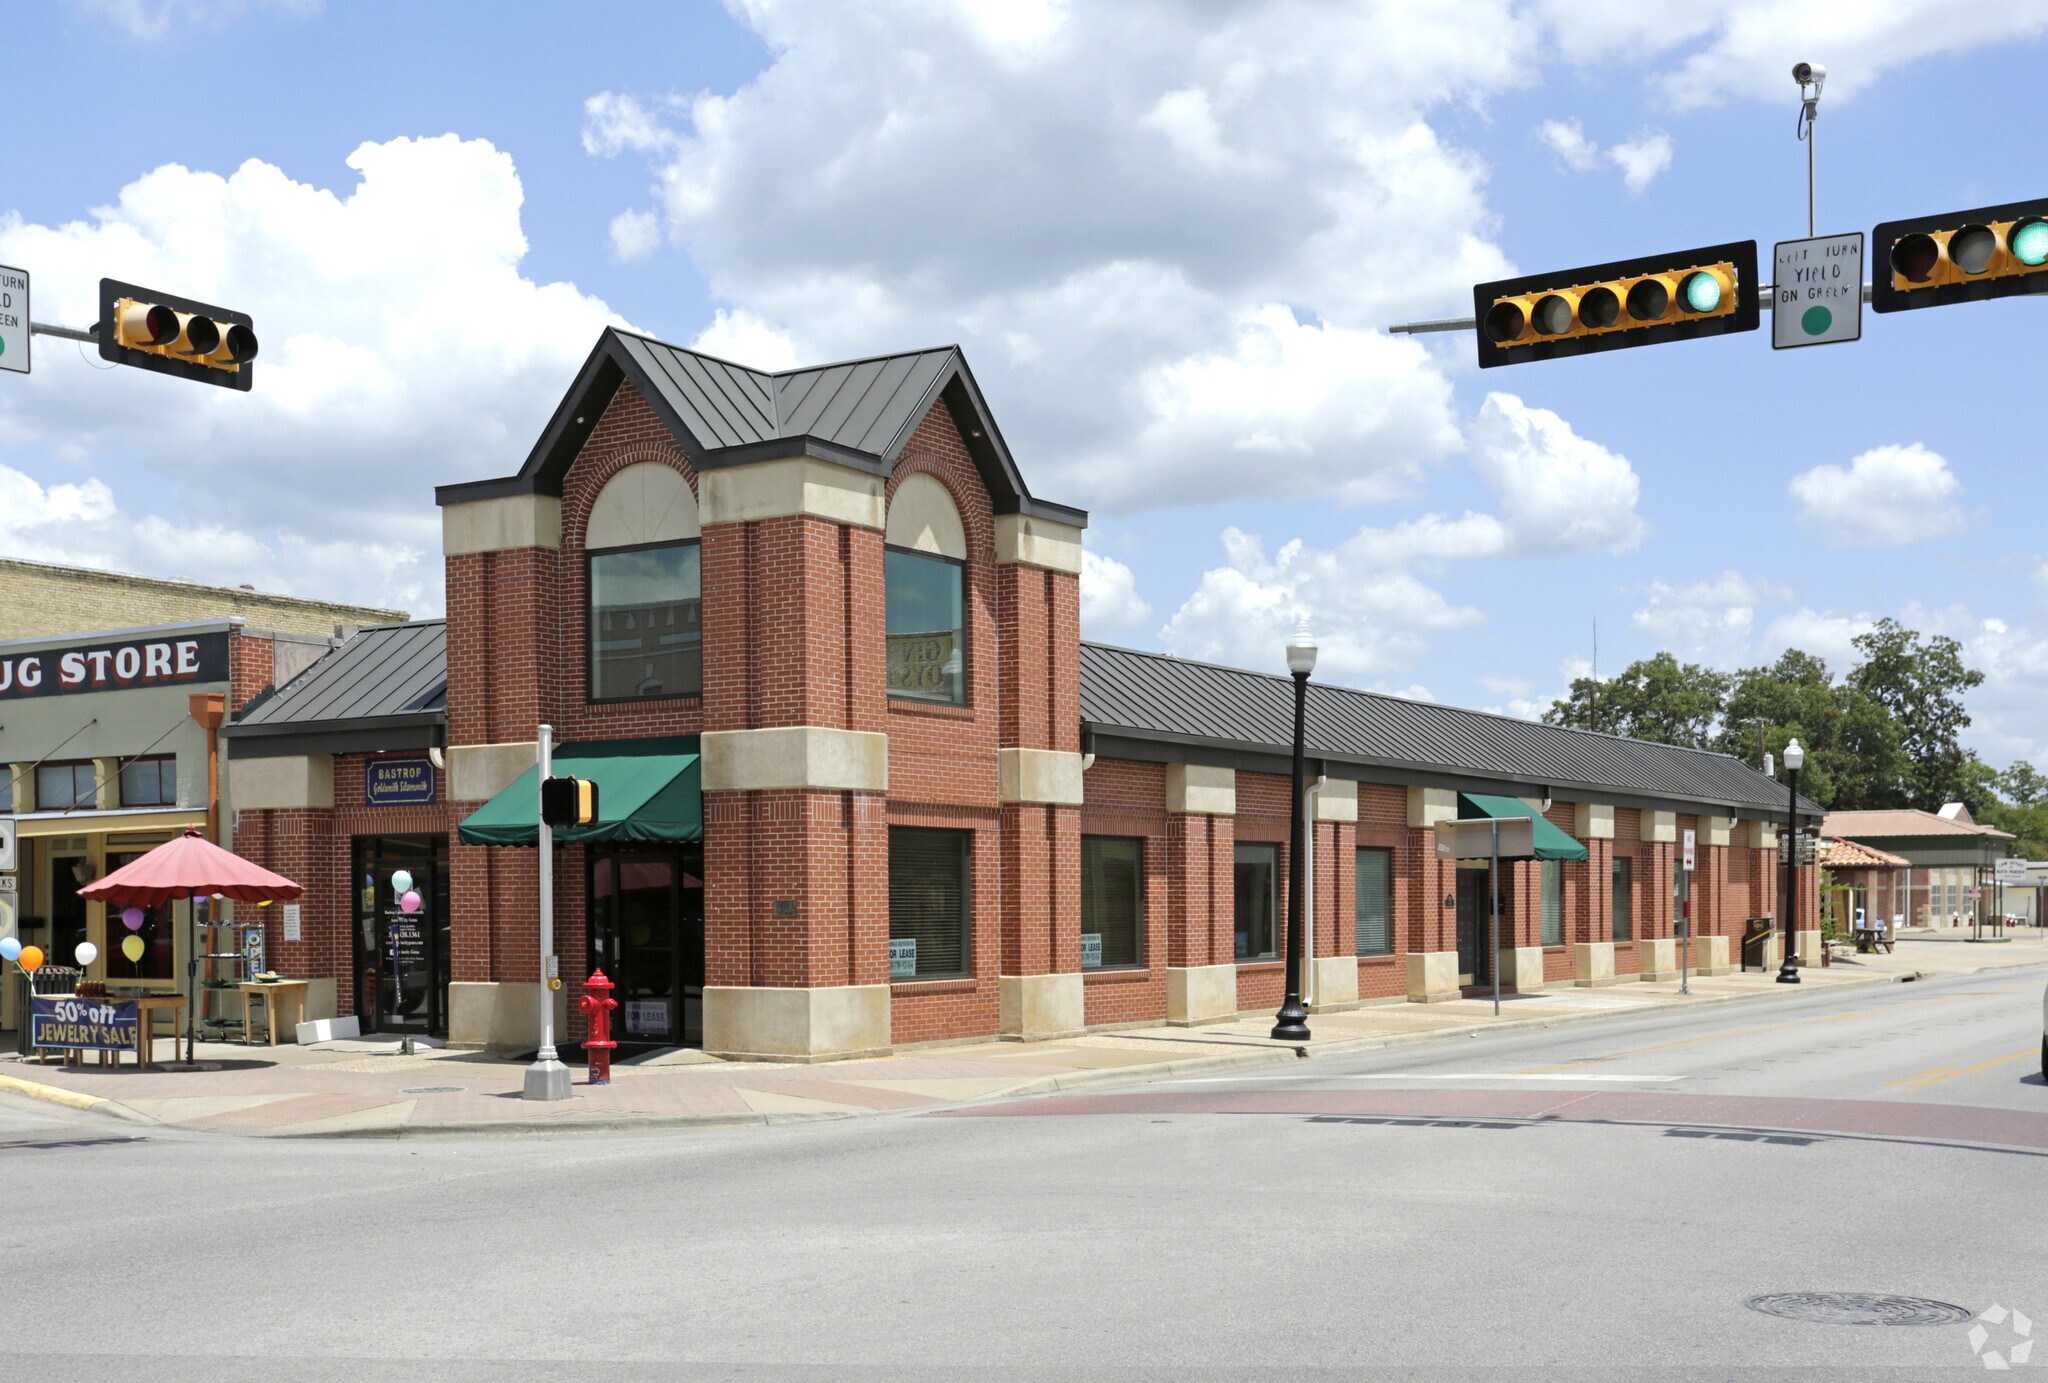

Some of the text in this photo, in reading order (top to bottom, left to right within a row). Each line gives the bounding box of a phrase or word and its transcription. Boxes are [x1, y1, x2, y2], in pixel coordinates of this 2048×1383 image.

[1826, 243, 1858, 258] TURN
[1794, 264, 1841, 283] YIELD
[0, 274, 25, 290] URN
[1781, 284, 1849, 303] ON GREEN
[0, 313, 18, 327] EEN
[0, 640, 200, 691] UG STORE
[378, 767, 422, 780] BASTROP
[889, 948, 915, 958] OR LEASE
[1089, 942, 1101, 952] LEASE
[54, 1001, 116, 1025] 50% off
[627, 1011, 665, 1022] FOR LEASE
[37, 1023, 136, 1045] JEWELRY SALE
